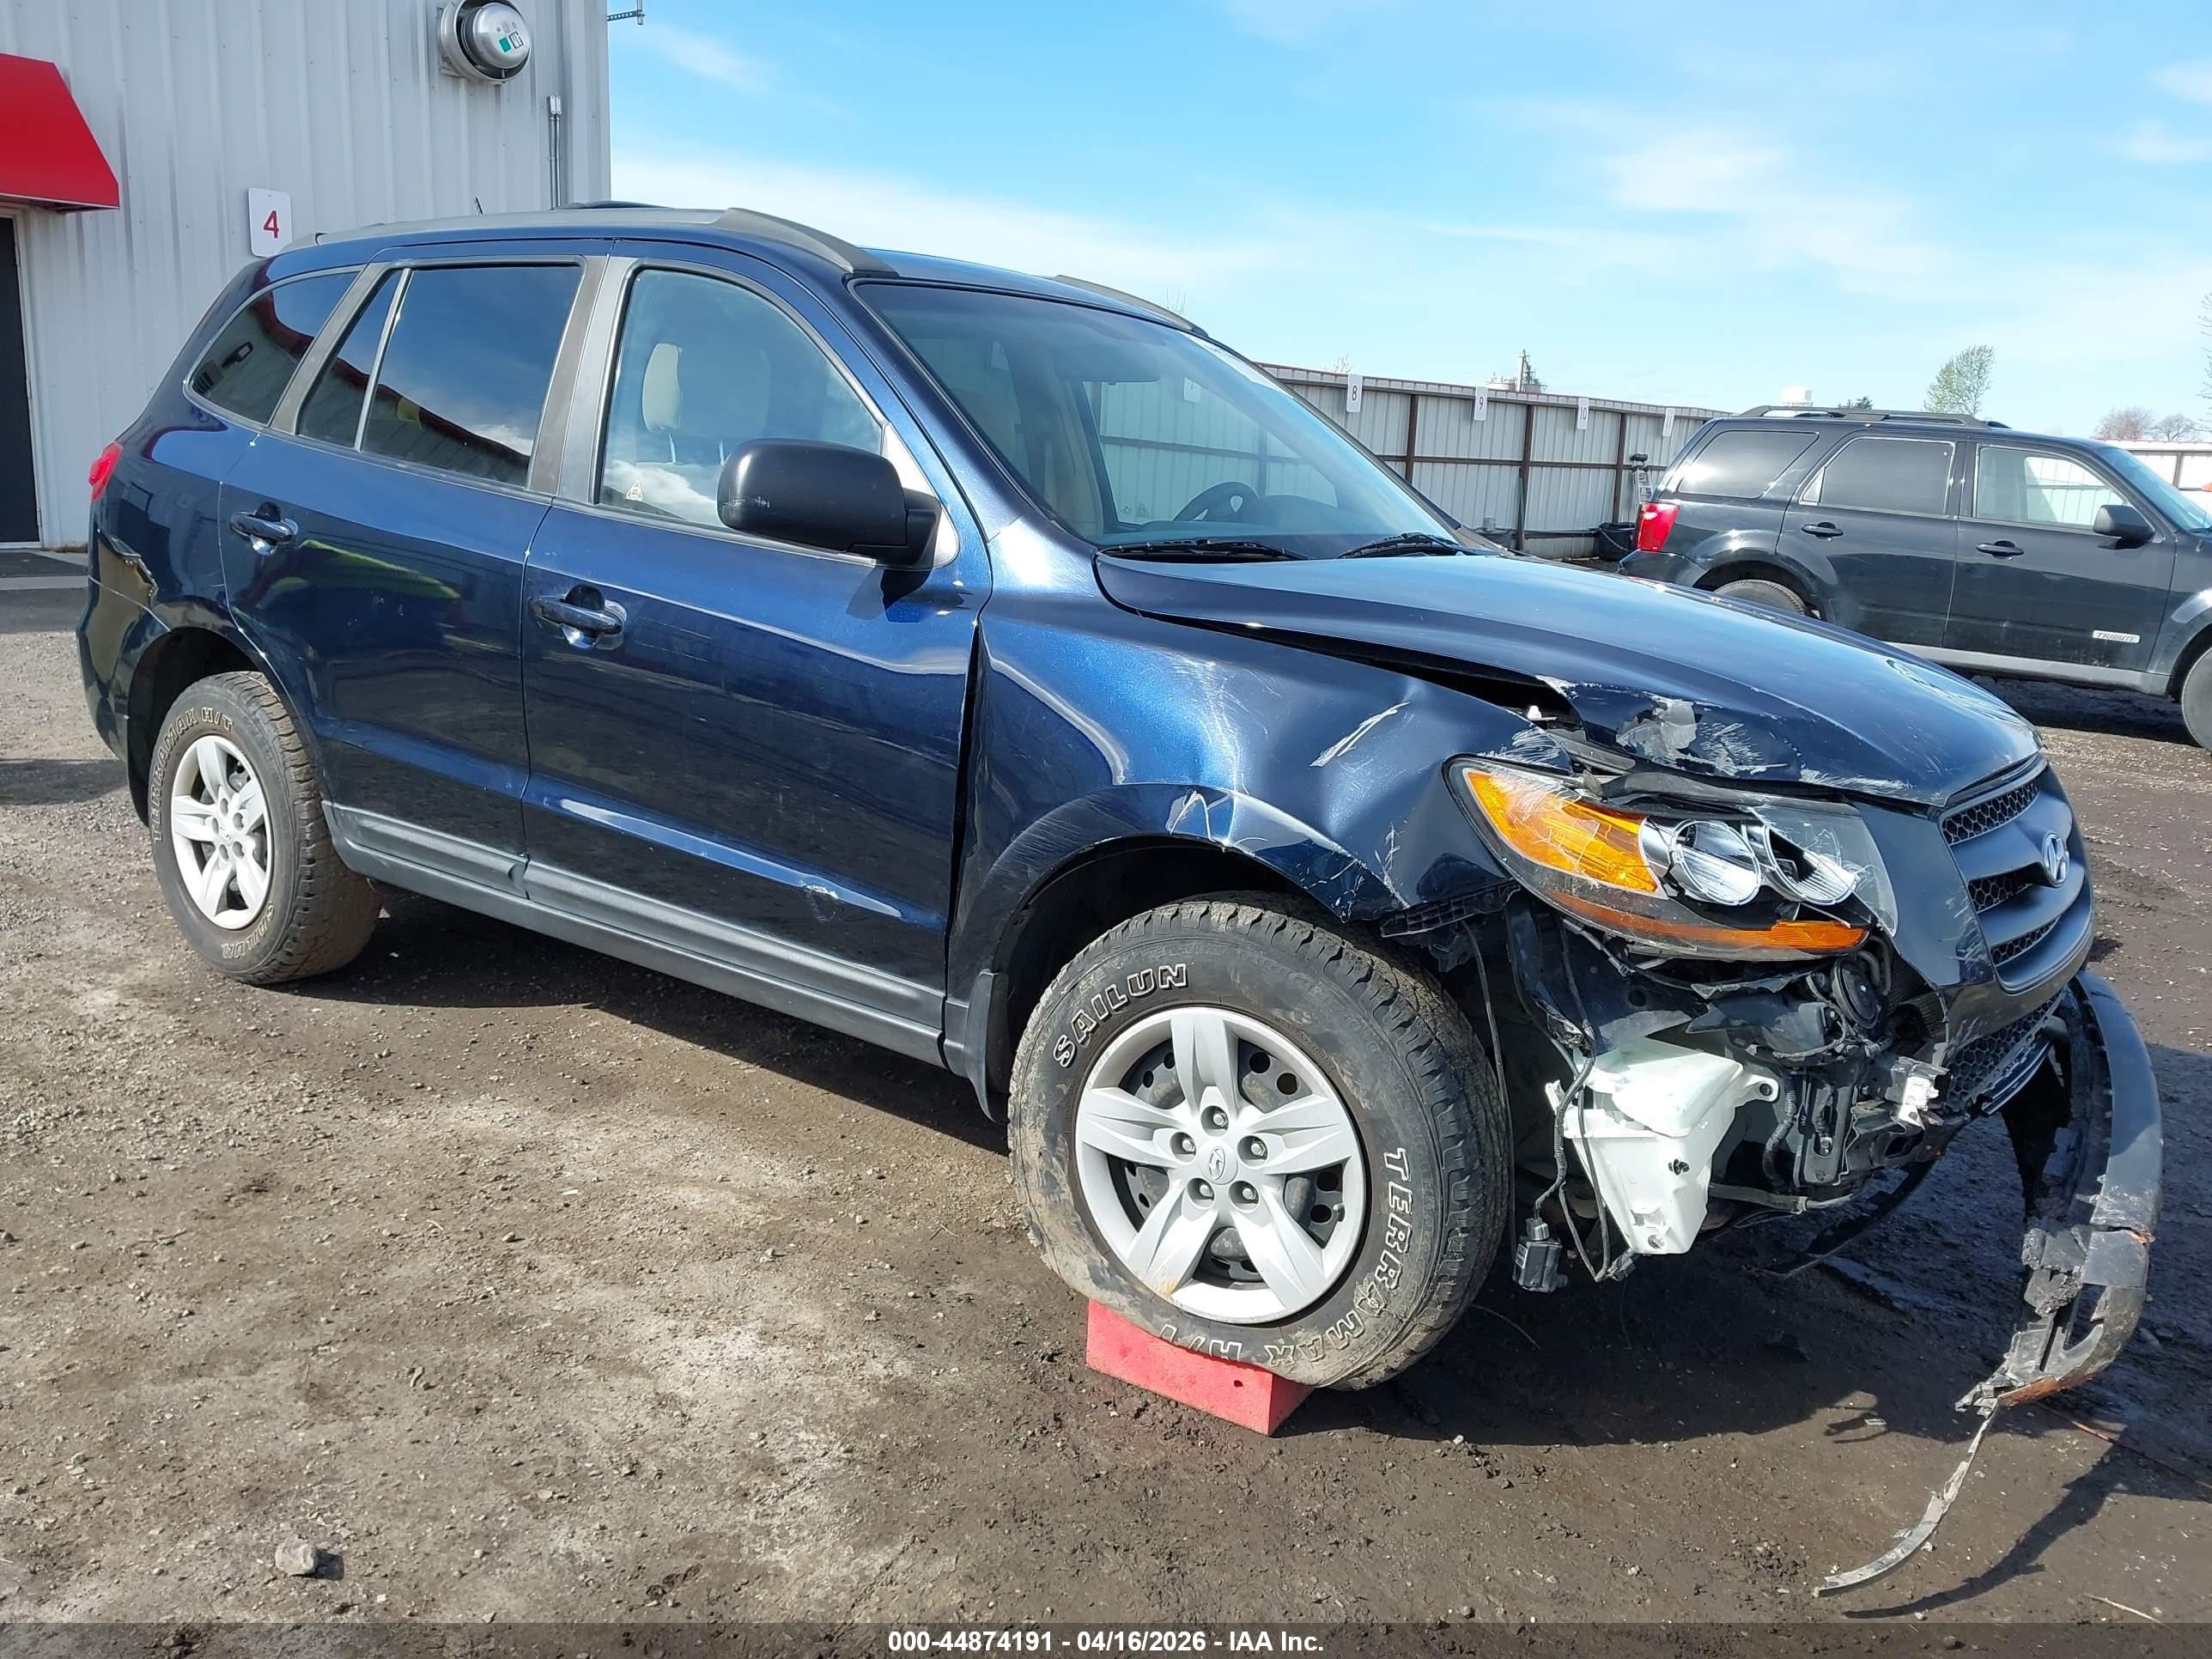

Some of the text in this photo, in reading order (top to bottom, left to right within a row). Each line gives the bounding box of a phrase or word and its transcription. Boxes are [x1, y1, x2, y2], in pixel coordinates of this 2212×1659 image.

[263, 210, 280, 239] 4
[1352, 385, 1358, 402] 8
[1479, 396, 1485, 410] 9
[1579, 405, 1588, 421] 10
[2096, 632, 2137, 642] TRIBUTE
[151, 708, 198, 845] TERRAMAX
[222, 901, 275, 959] SAILUN
[1053, 963, 1188, 1068] SAILUN
[1264, 1146, 1413, 1367] TERRAMAX
